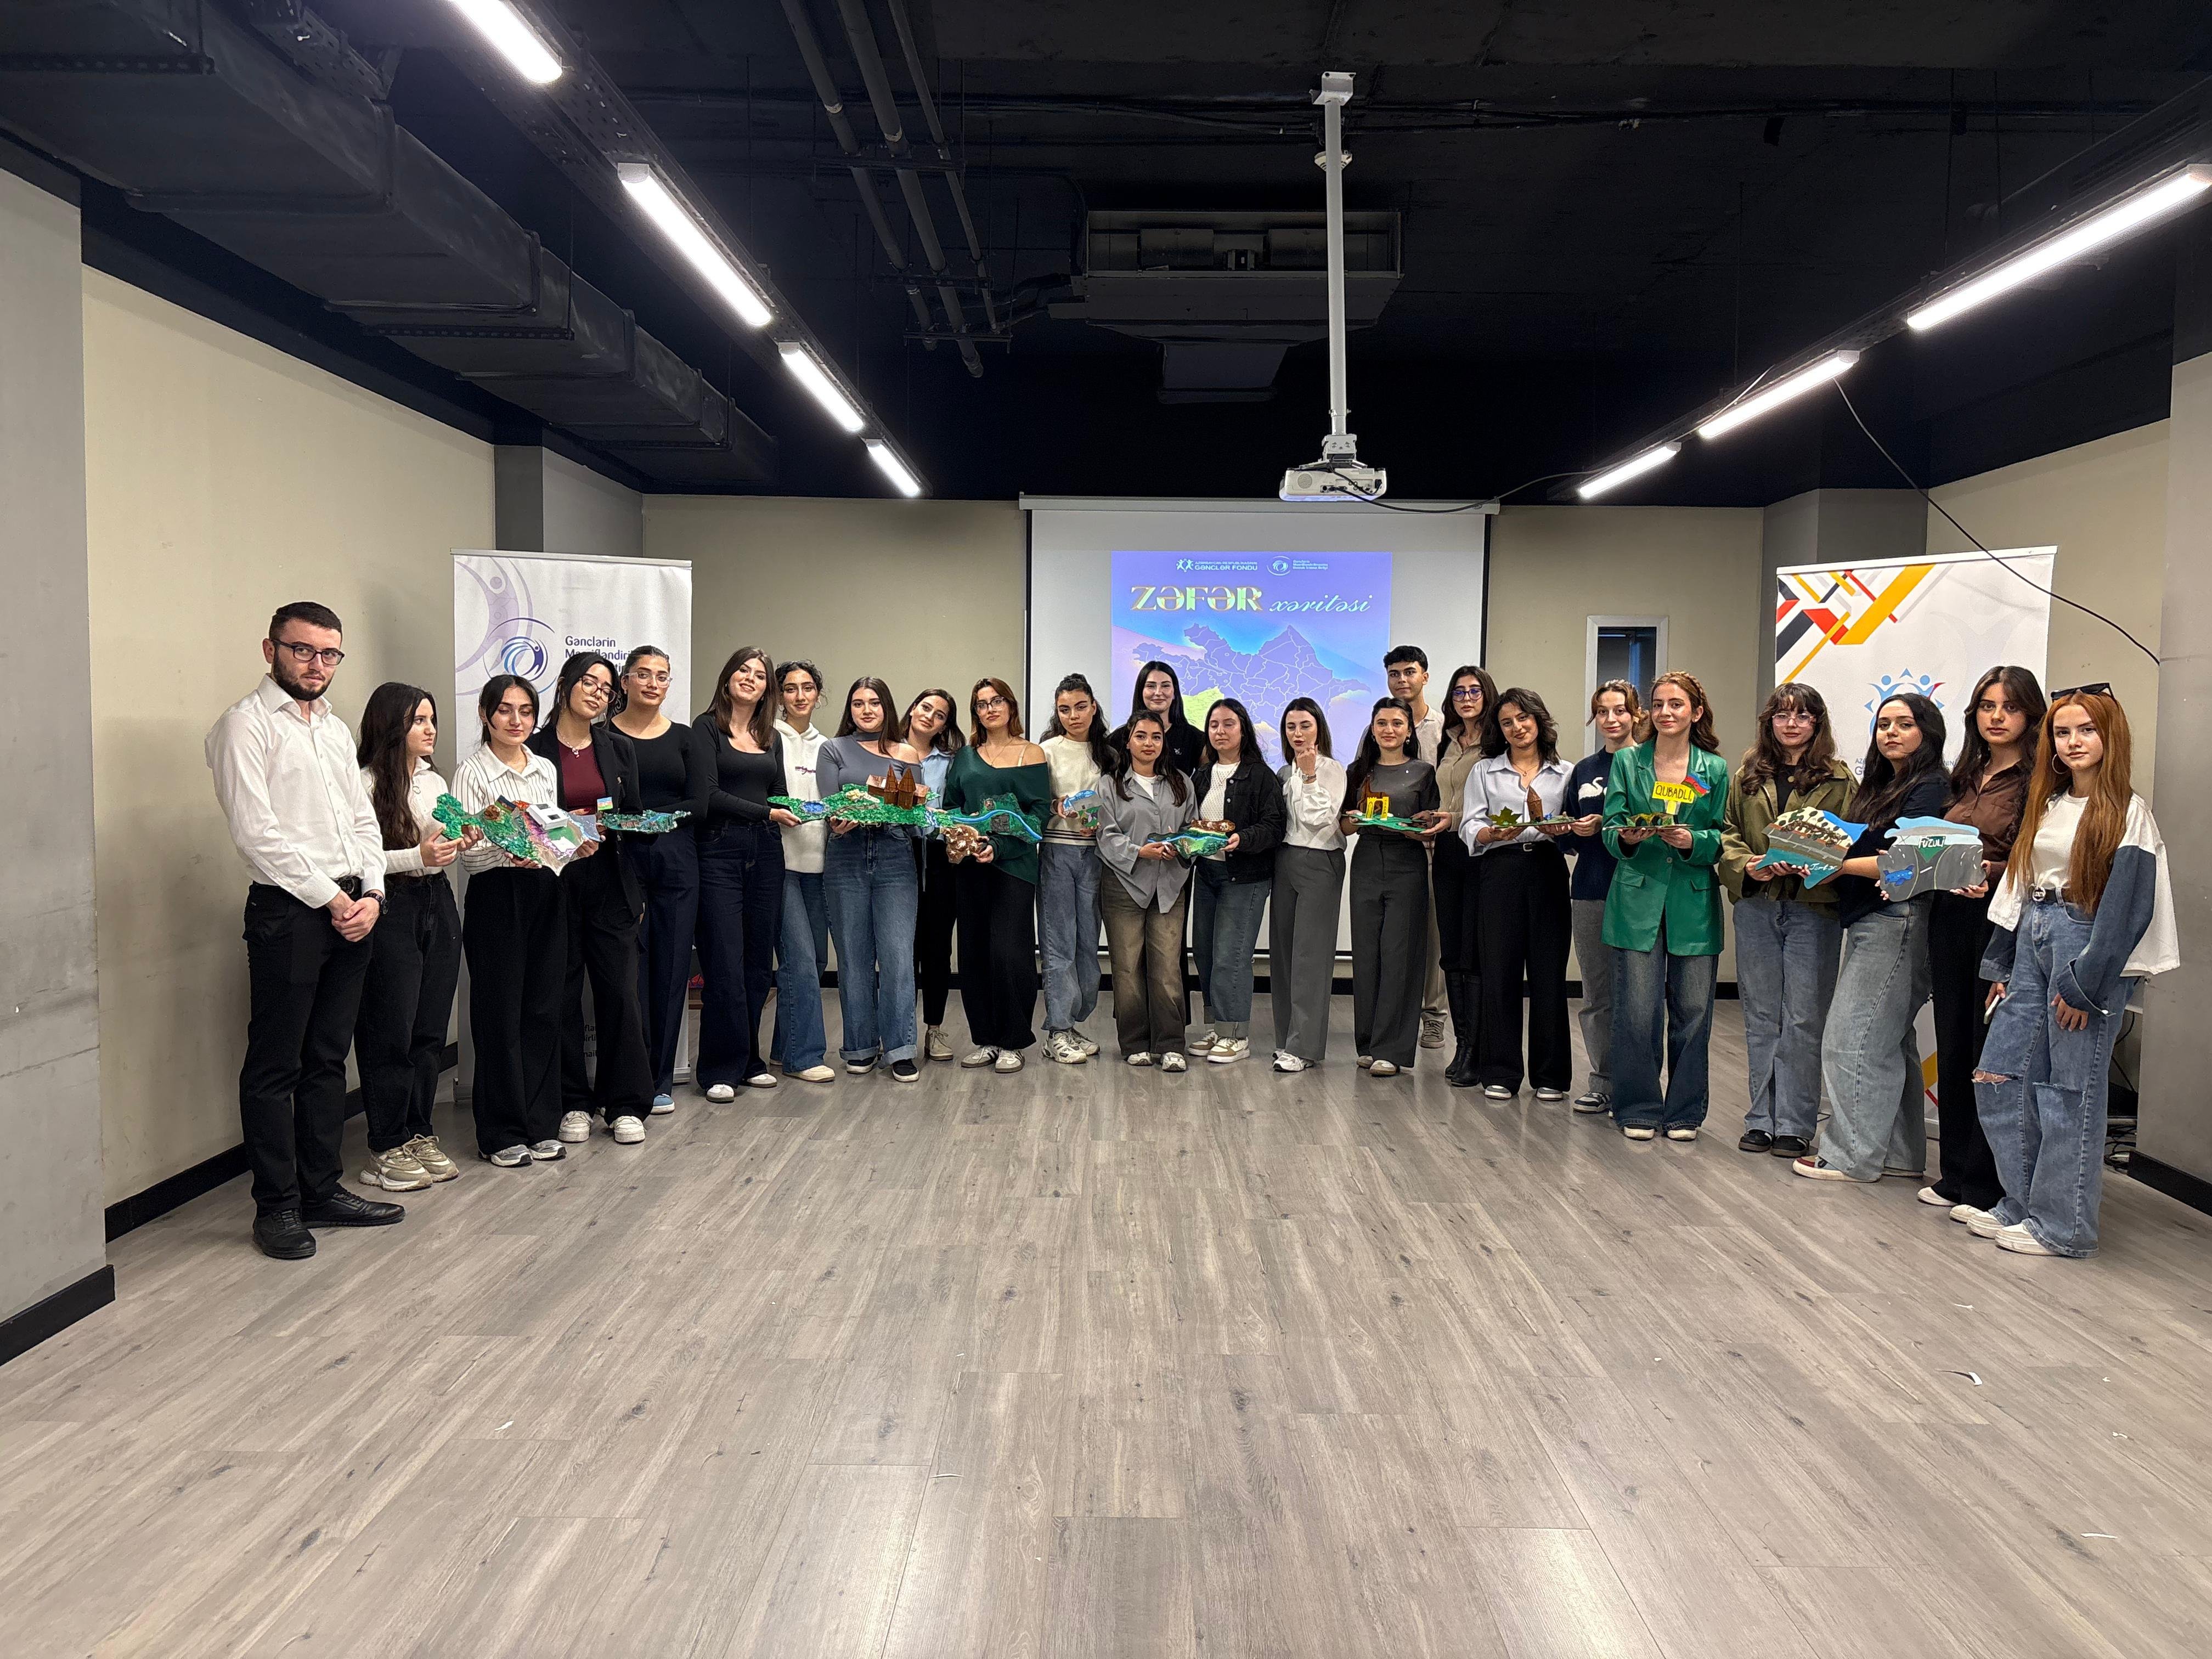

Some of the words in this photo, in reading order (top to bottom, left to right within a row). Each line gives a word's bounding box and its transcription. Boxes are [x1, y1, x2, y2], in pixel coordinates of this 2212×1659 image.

[1130, 585, 1263, 612] ZƏFƏR
[1268, 594, 1373, 612] xəritəsi
[565, 635, 616, 647] Gənclərin
[1655, 785, 1692, 800] QUBADLI
